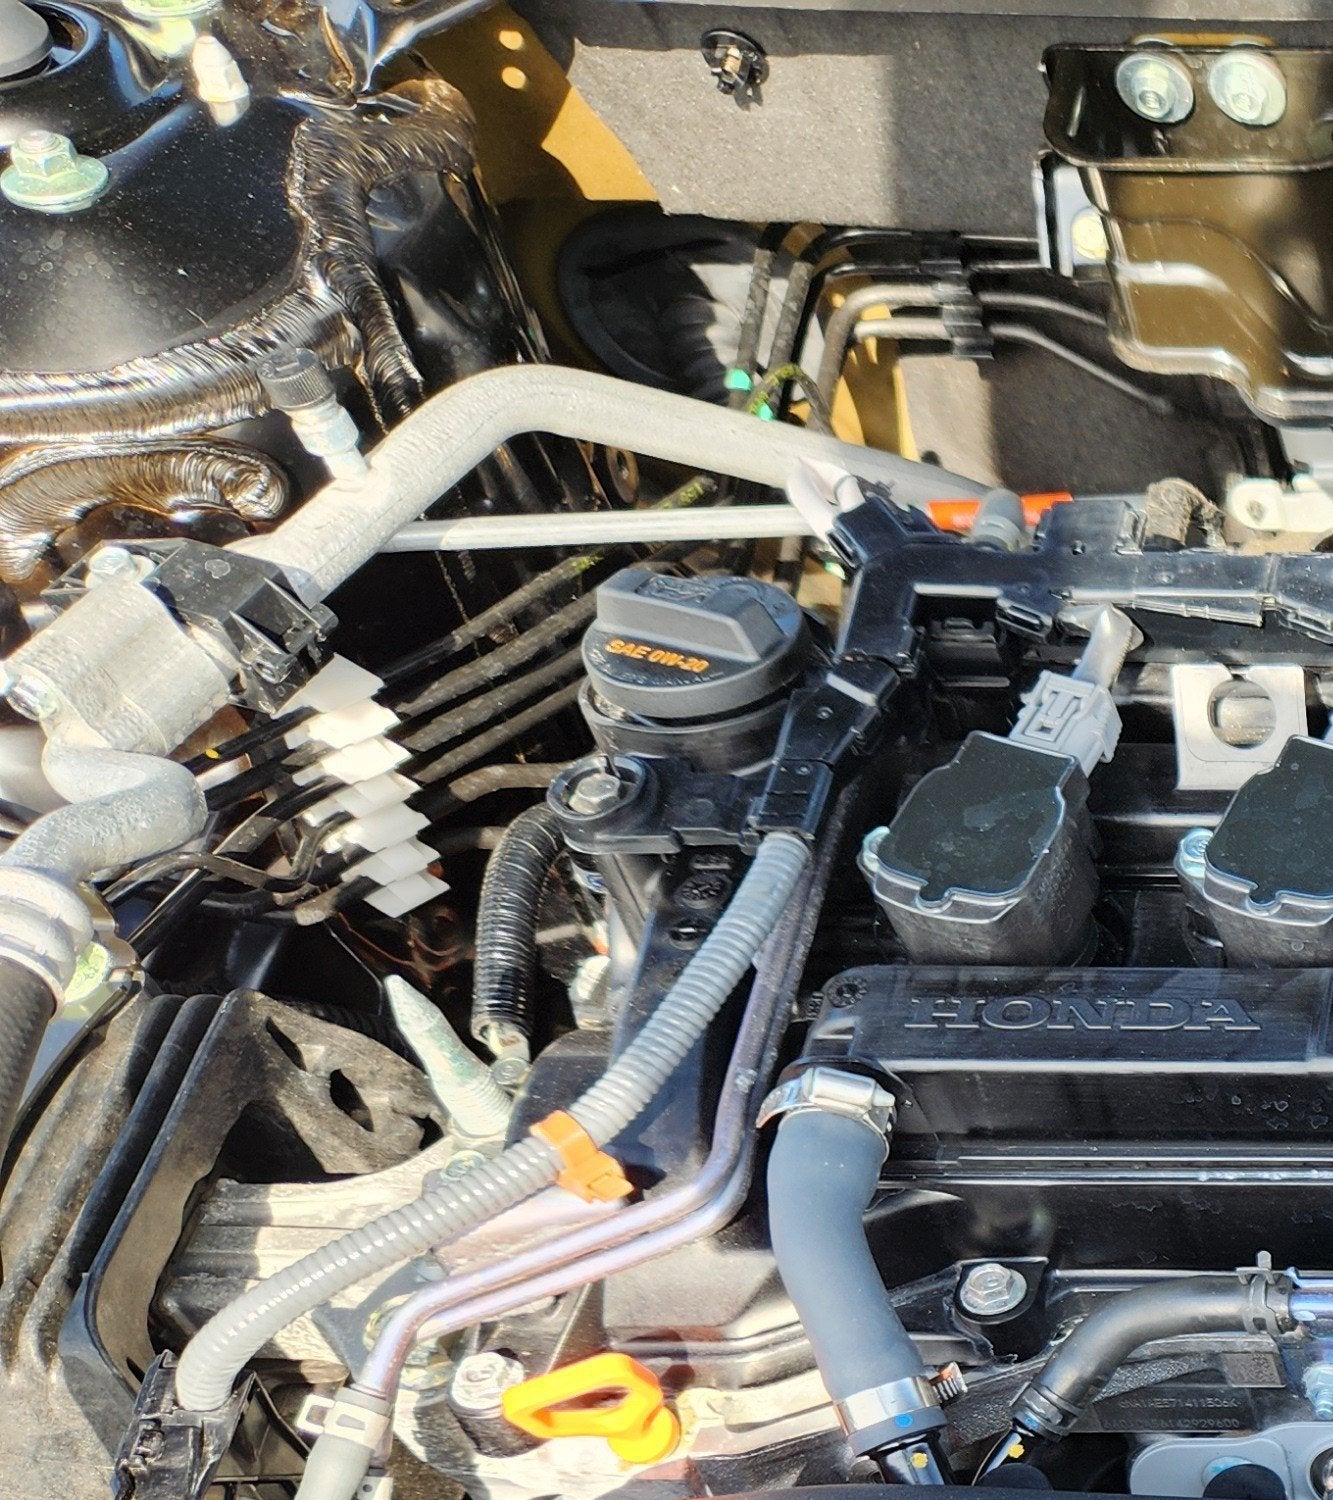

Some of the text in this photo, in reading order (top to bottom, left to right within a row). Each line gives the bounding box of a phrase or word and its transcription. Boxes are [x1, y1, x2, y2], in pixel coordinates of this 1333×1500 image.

[605, 639, 652, 659] SAE
[648, 650, 709, 673] 0W-20
[904, 998, 1261, 1030] HONDA
